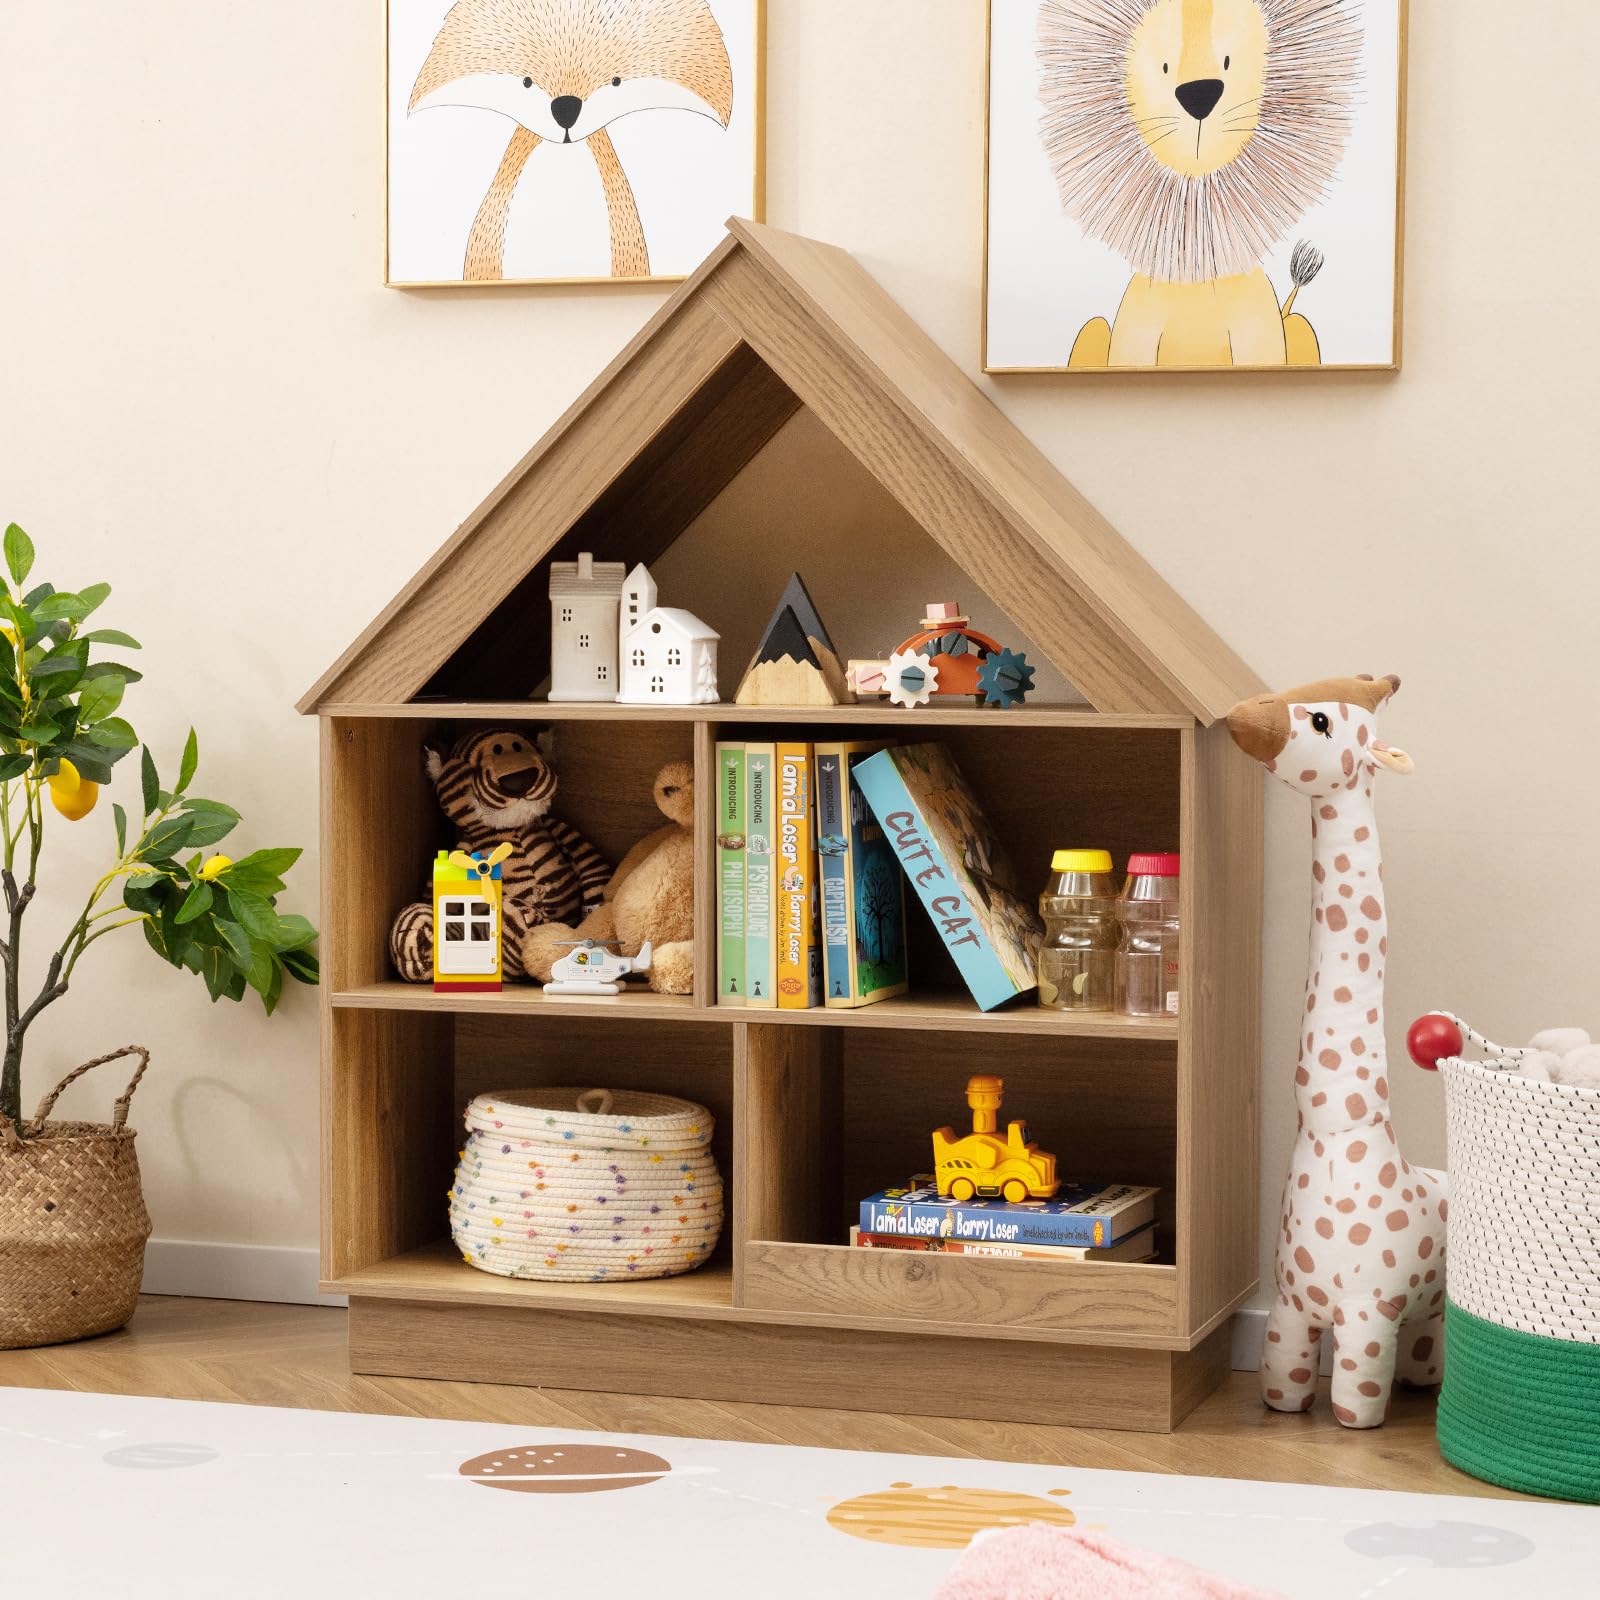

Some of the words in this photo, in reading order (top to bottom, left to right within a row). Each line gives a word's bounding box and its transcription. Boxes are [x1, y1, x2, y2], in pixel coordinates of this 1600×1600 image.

[728, 767, 737, 820] INTRODUCING
[753, 771, 762, 824] INTRODUCING
[781, 798, 797, 811] a
[782, 764, 798, 795] am
[825, 772, 835, 824] INTRODUCING
[781, 814, 805, 863] Loser
[723, 861, 744, 938] PHILOSOPHY
[747, 865, 769, 938] PSYCHOLOGY
[885, 811, 945, 889] CUTE
[931, 895, 981, 950] CAT
[788, 894, 806, 931] Barry
[824, 877, 847, 945] CAPITALISM
[788, 932, 802, 965] Loser
[870, 1204, 875, 1231] I
[876, 1215, 896, 1233] am
[897, 1217, 906, 1234] a
[907, 1206, 939, 1235] Loser
[956, 1211, 989, 1240] Barry
[990, 1218, 1018, 1240] Loser
